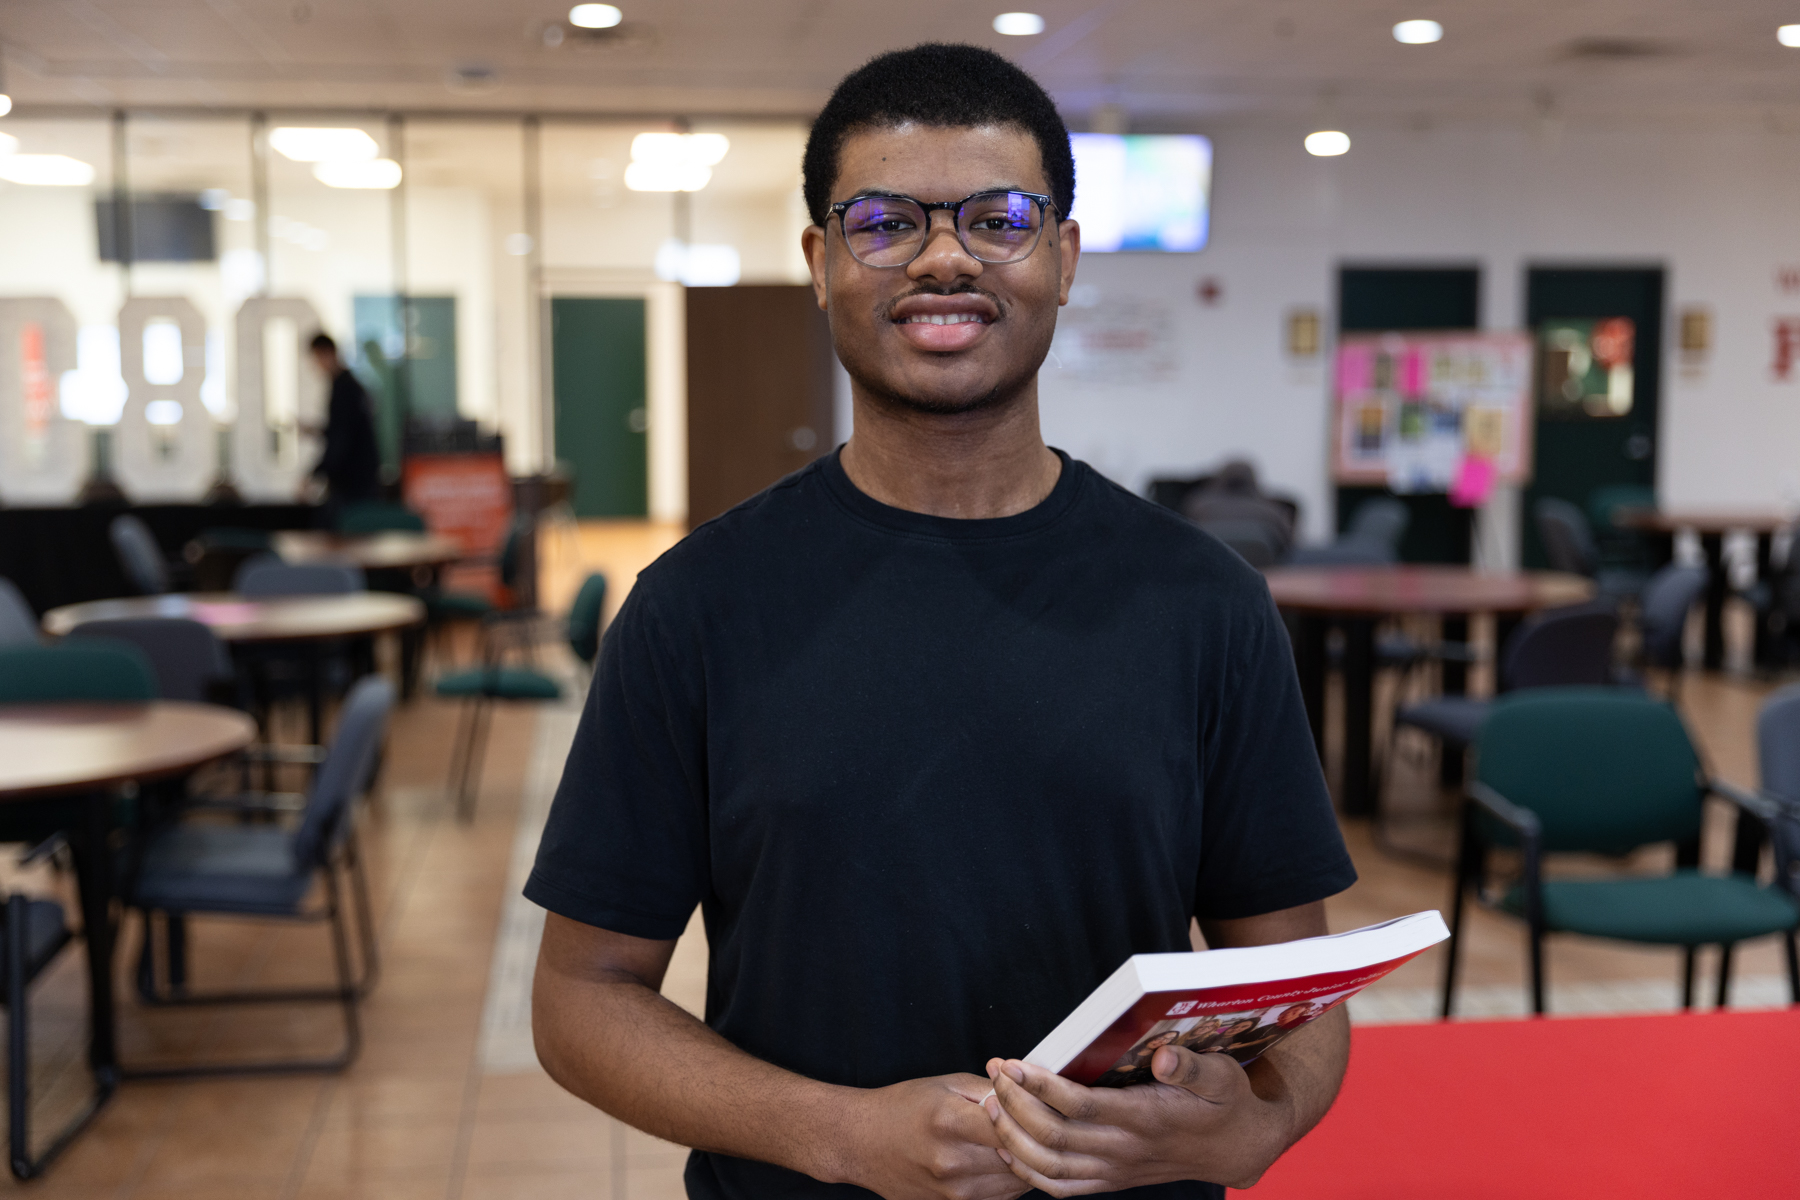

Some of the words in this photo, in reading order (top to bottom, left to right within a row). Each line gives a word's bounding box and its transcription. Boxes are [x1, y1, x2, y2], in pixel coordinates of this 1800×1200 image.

[1197, 998, 1254, 1010] Wharton
[1257, 990, 1303, 1002] County
[1303, 981, 1349, 995] Junior
